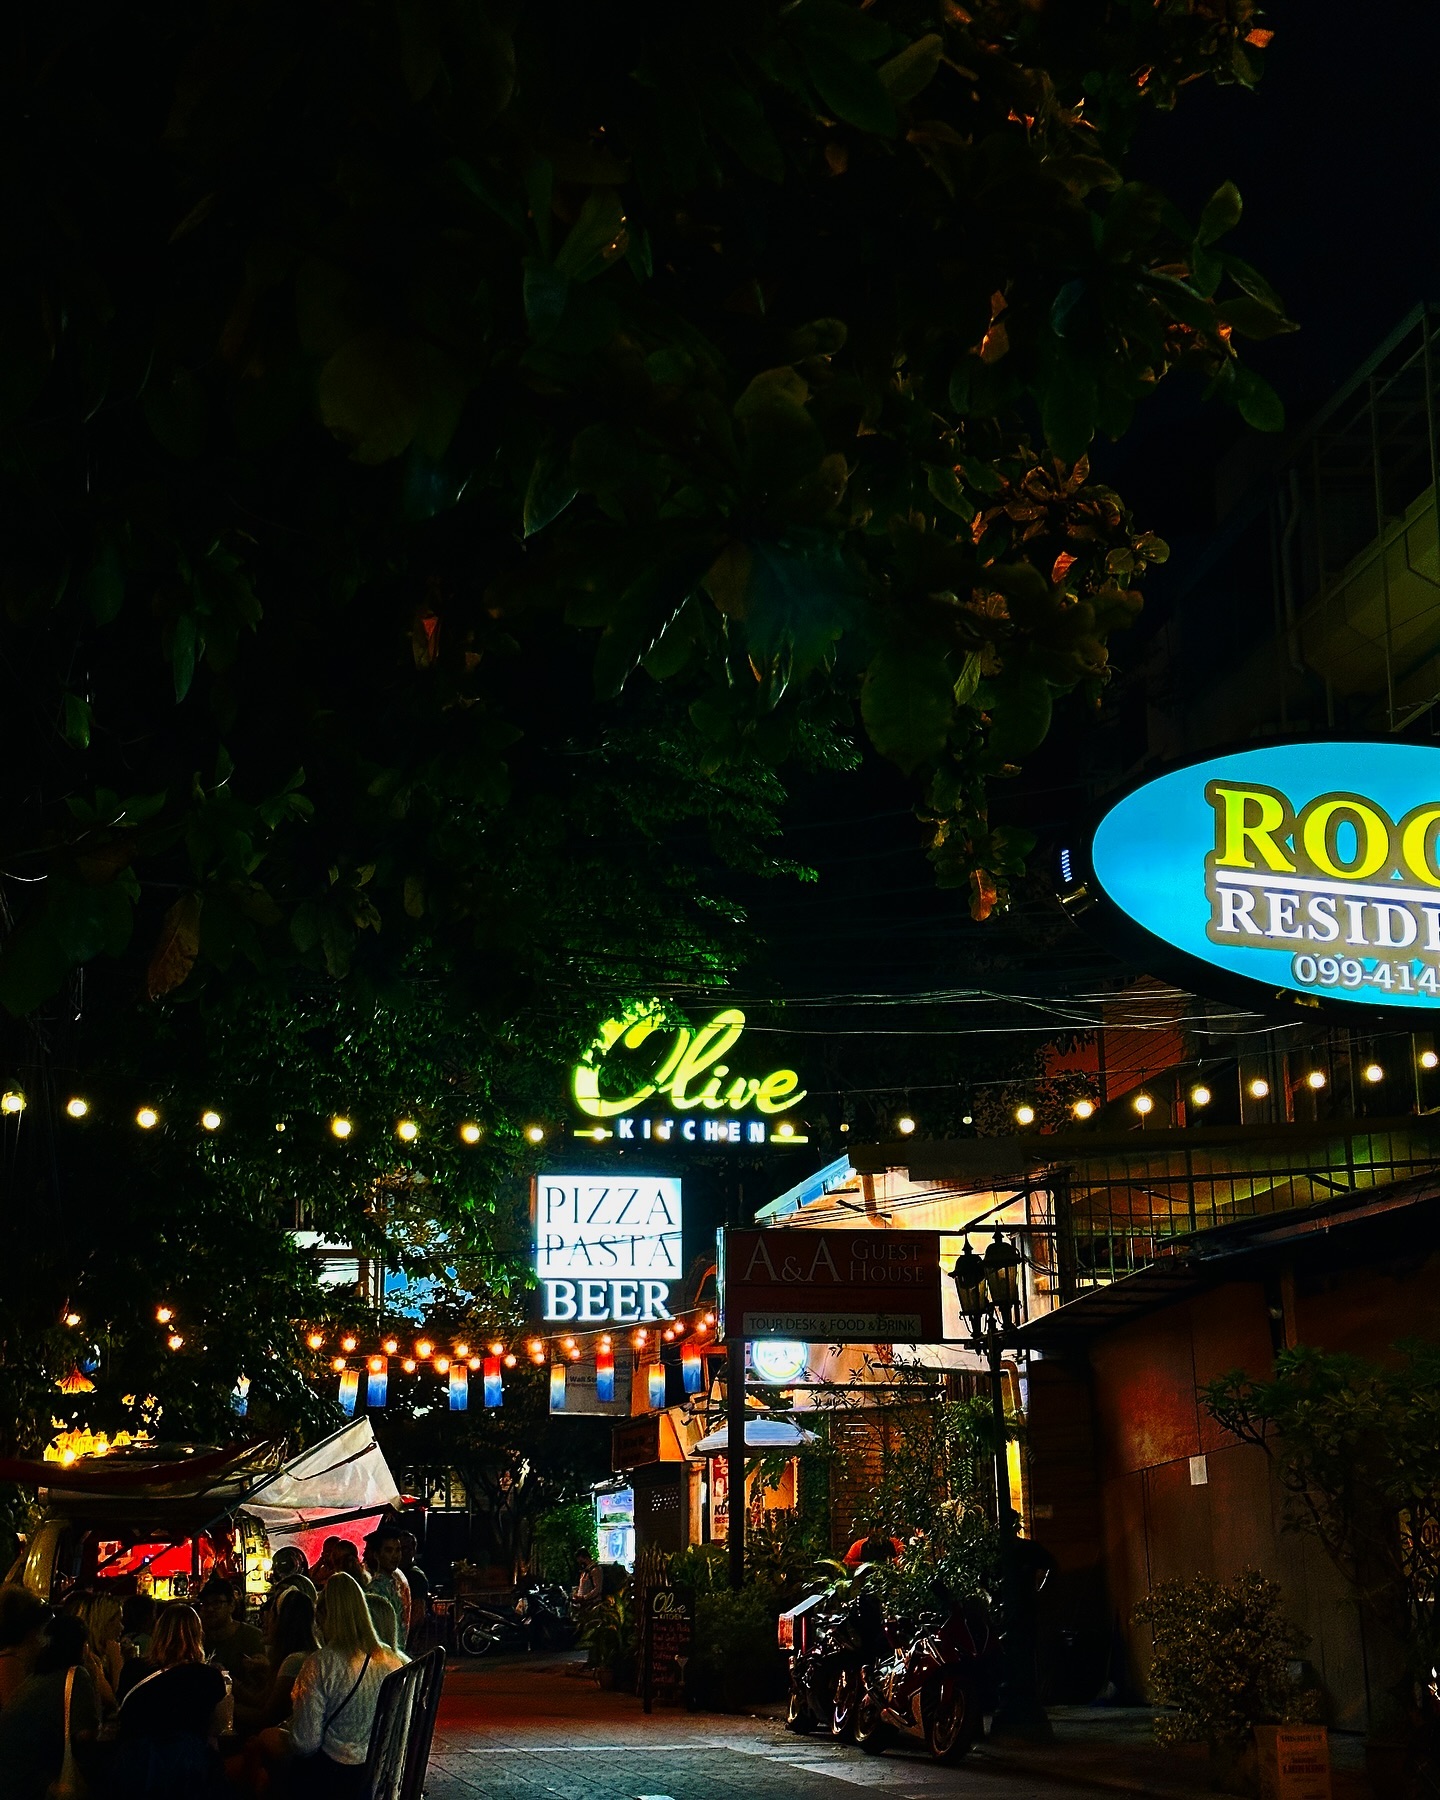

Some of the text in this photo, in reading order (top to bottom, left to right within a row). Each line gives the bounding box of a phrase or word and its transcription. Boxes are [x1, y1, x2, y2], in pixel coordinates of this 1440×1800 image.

[574, 1003, 808, 1118] Olive
[619, 1118, 766, 1143] KITCHEN
[544, 1186, 676, 1225] PIZZA
[544, 1233, 676, 1268] PASTA
[740, 1234, 844, 1283] A&A
[849, 1260, 925, 1283] HOUSE
[542, 1279, 676, 1321] BEER
[749, 1318, 784, 1331] TOUR
[785, 1318, 817, 1330] DESK
[829, 1318, 866, 1331] FOOD
[653, 1592, 687, 1614] Olive
